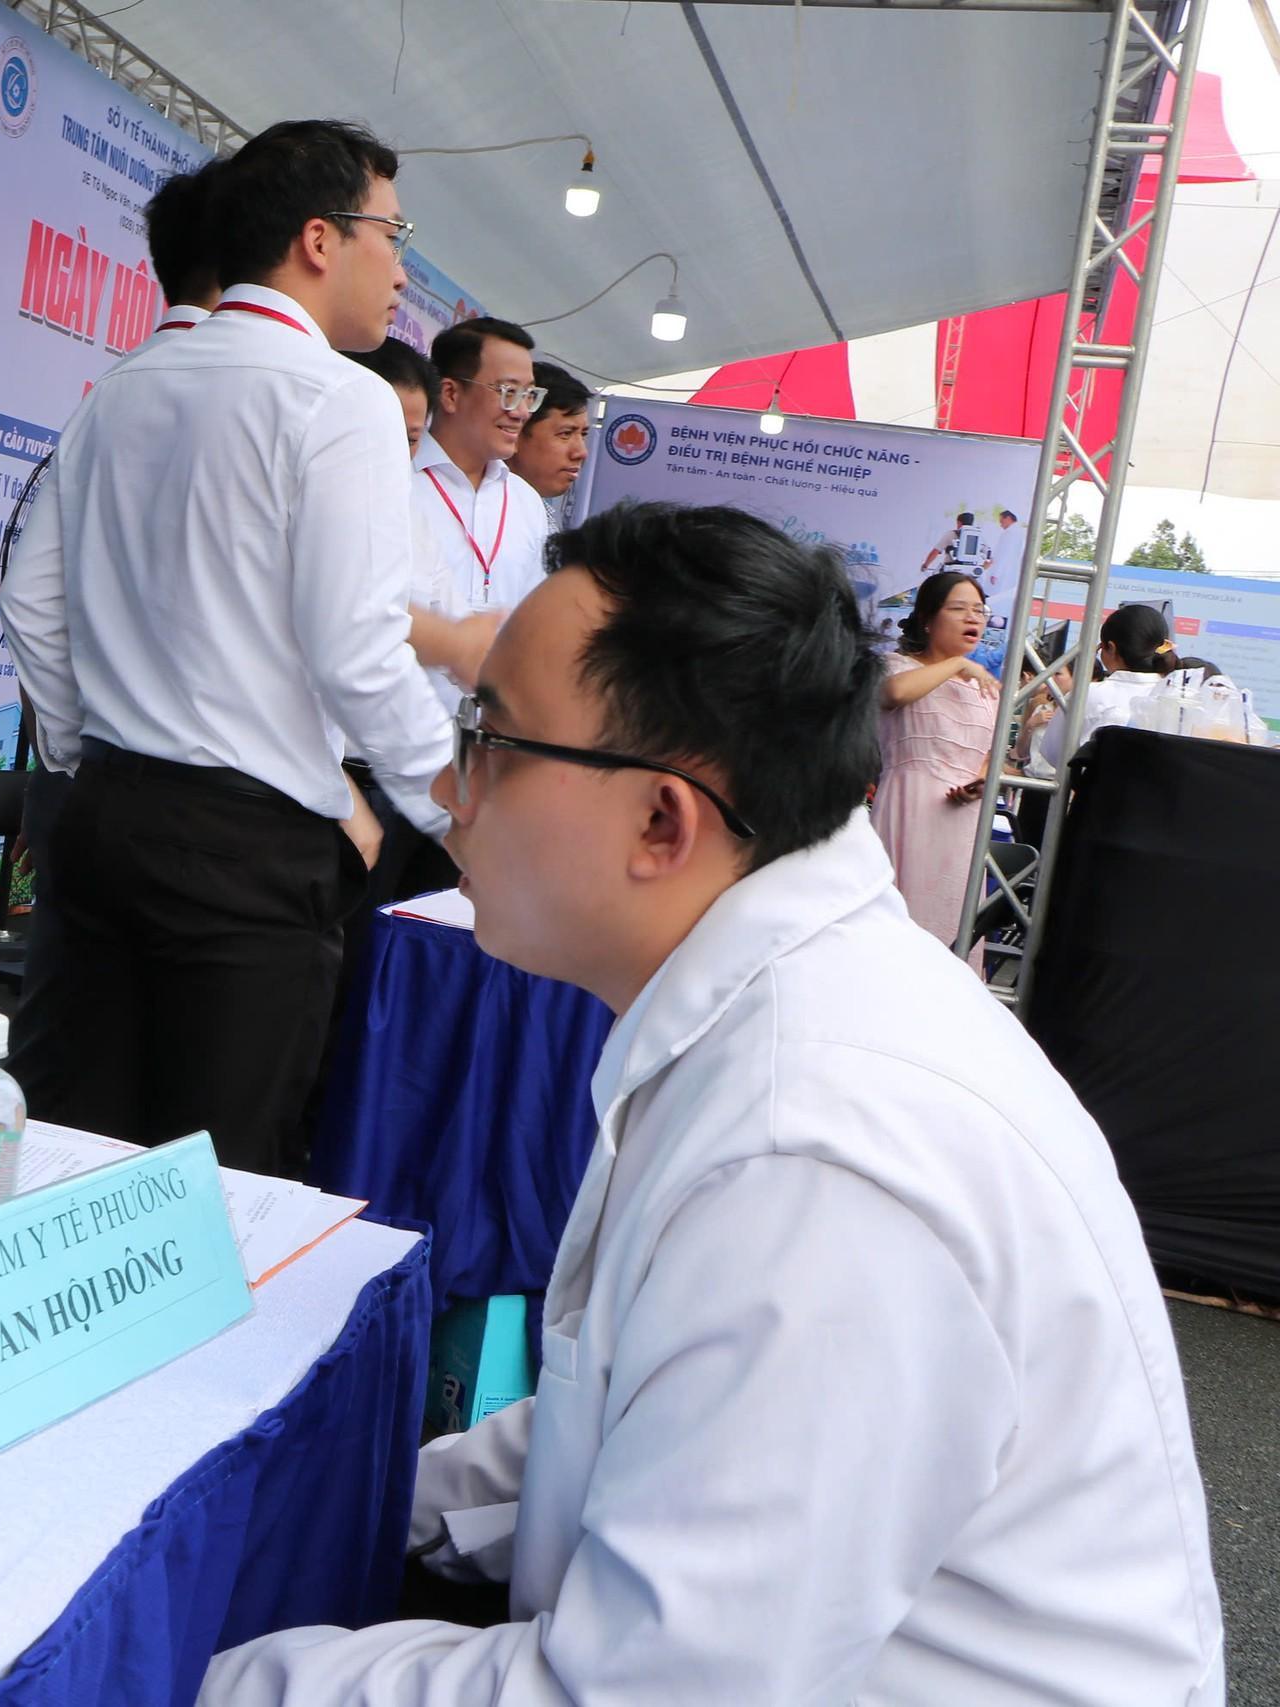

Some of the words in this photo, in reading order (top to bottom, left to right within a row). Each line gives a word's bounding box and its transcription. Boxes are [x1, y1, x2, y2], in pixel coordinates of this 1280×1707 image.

[61, 114, 91, 153] TRUNG
[123, 116, 130, 135] Y
[141, 130, 171, 163] THÀNH
[170, 149, 190, 173] PHỐ
[19, 218, 110, 342] NGÀY
[3, 426, 26, 452] CẦU
[671, 425, 709, 441] BỆNH
[713, 430, 746, 447] VIỆN
[748, 436, 789, 453] PHỤC
[823, 444, 864, 460] CHỨC
[866, 448, 911, 466] NĂNG
[3, 473, 10, 498] Y
[705, 449, 728, 465] TRỊ
[731, 450, 770, 468] BỆNH
[817, 463, 873, 482] NGHIỆP
[715, 469, 730, 479] An
[732, 471, 756, 482] toàn
[764, 475, 789, 487] Chất
[830, 483, 855, 495] Hiệu
[27, 1221, 46, 1260] Y
[52, 1197, 89, 1250] TẾ
[88, 1166, 188, 1236] PHƯỜNG
[0, 1304, 42, 1363] AN
[41, 1276, 105, 1333] HỘI
[104, 1238, 184, 1307] ĐÔNG
